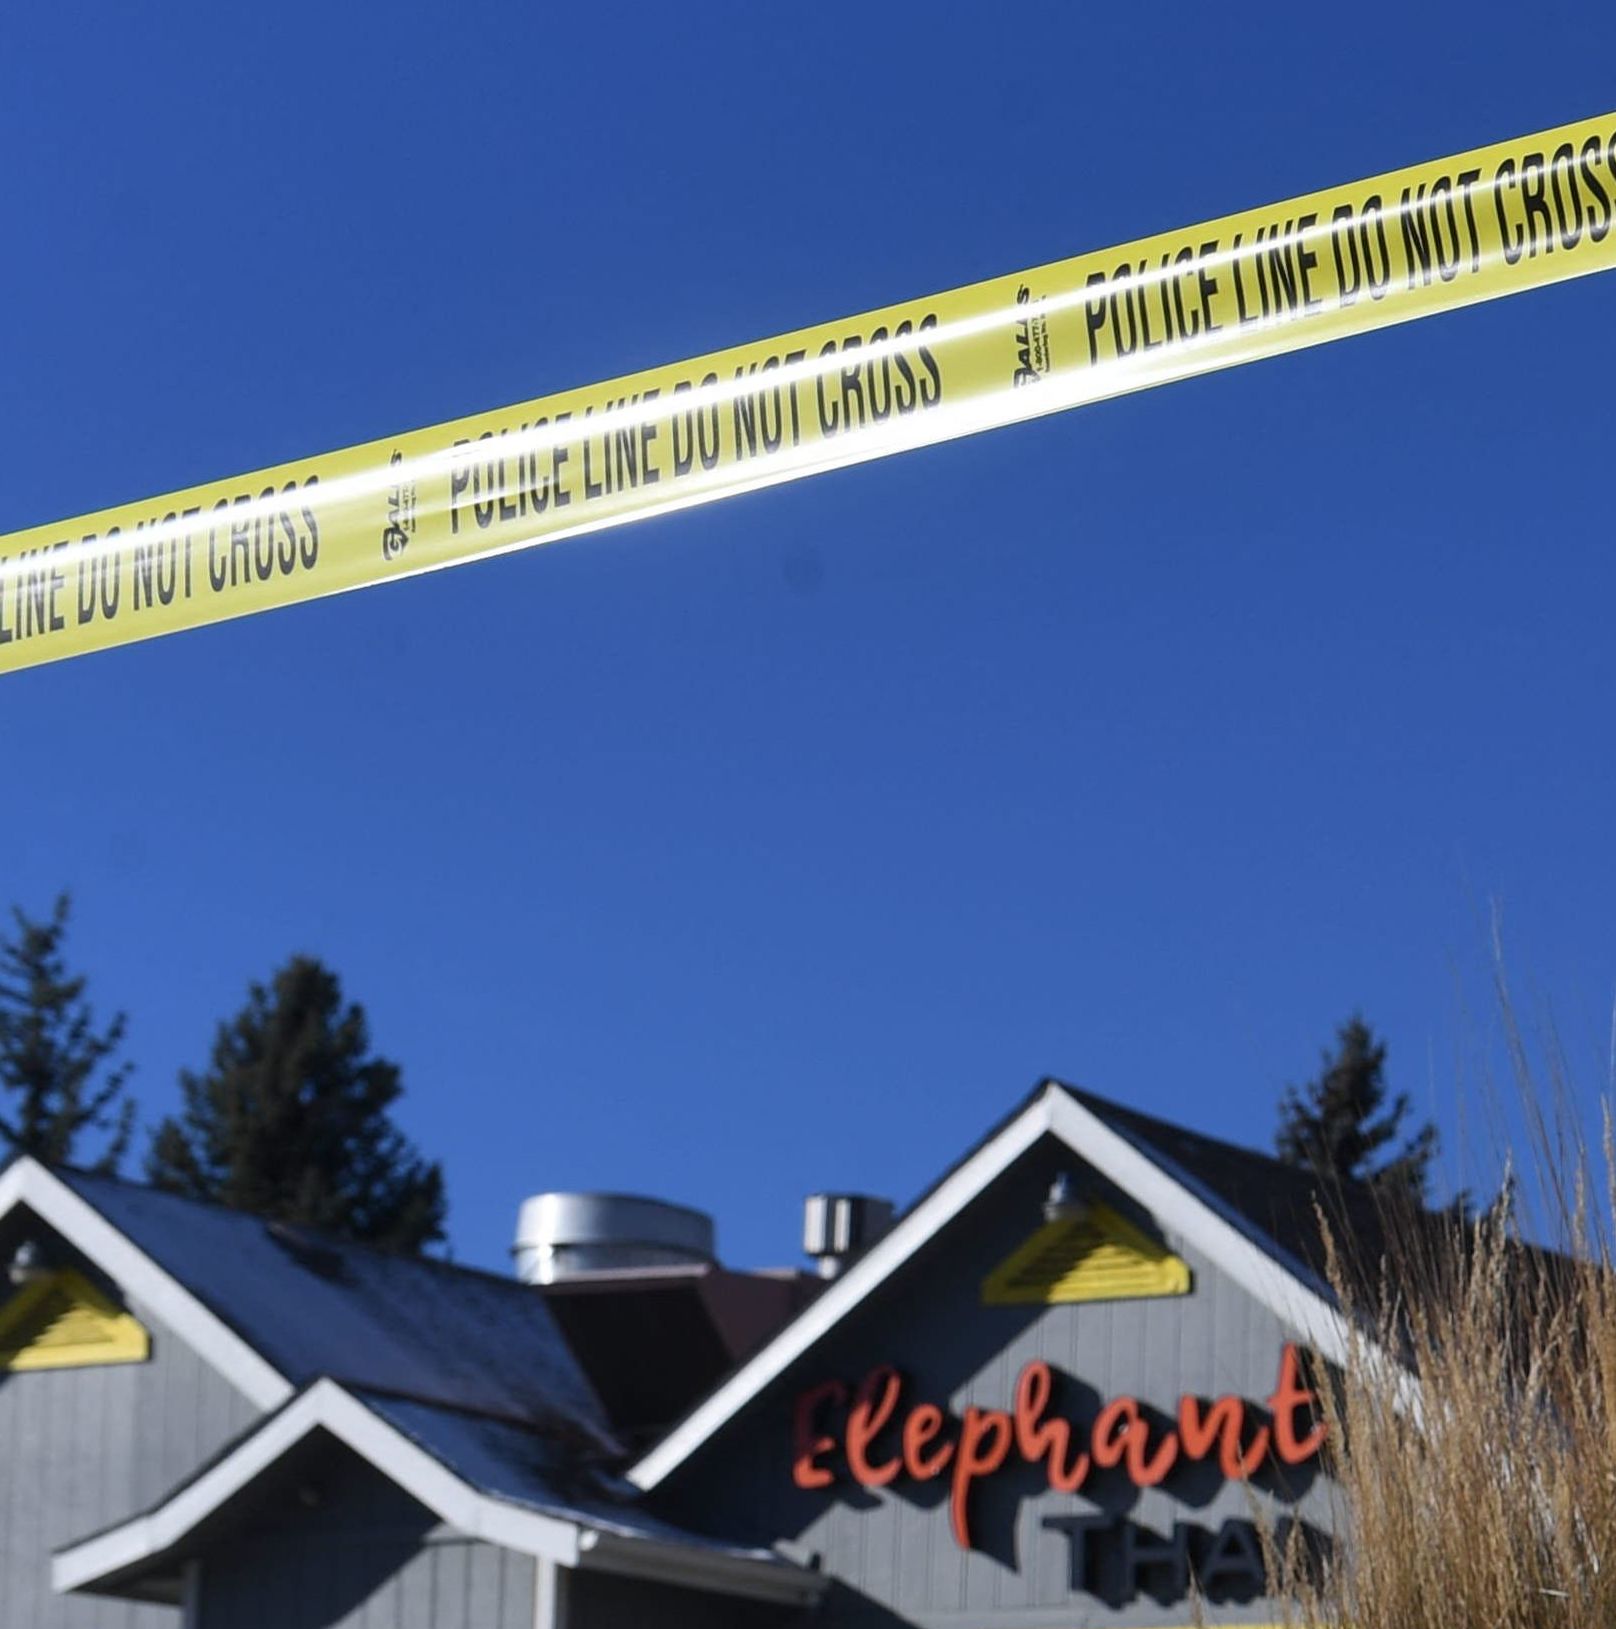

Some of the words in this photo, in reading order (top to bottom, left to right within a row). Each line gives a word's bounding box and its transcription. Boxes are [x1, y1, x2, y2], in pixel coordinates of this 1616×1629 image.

[1085, 240, 1223, 367] POLICE
[1232, 213, 1323, 333] LINE
[1331, 195, 1391, 309] DO
[1400, 168, 1482, 291] NOT
[450, 411, 573, 534] POLICE
[583, 388, 662, 500] LINE
[672, 372, 720, 477] DO
[734, 349, 806, 461] NOT
[816, 313, 943, 439] CROSS
[77, 526, 121, 625] DO
[132, 506, 201, 611] NOT
[208, 475, 319, 593] CROSS
[793, 1342, 1327, 1549] Elephant
